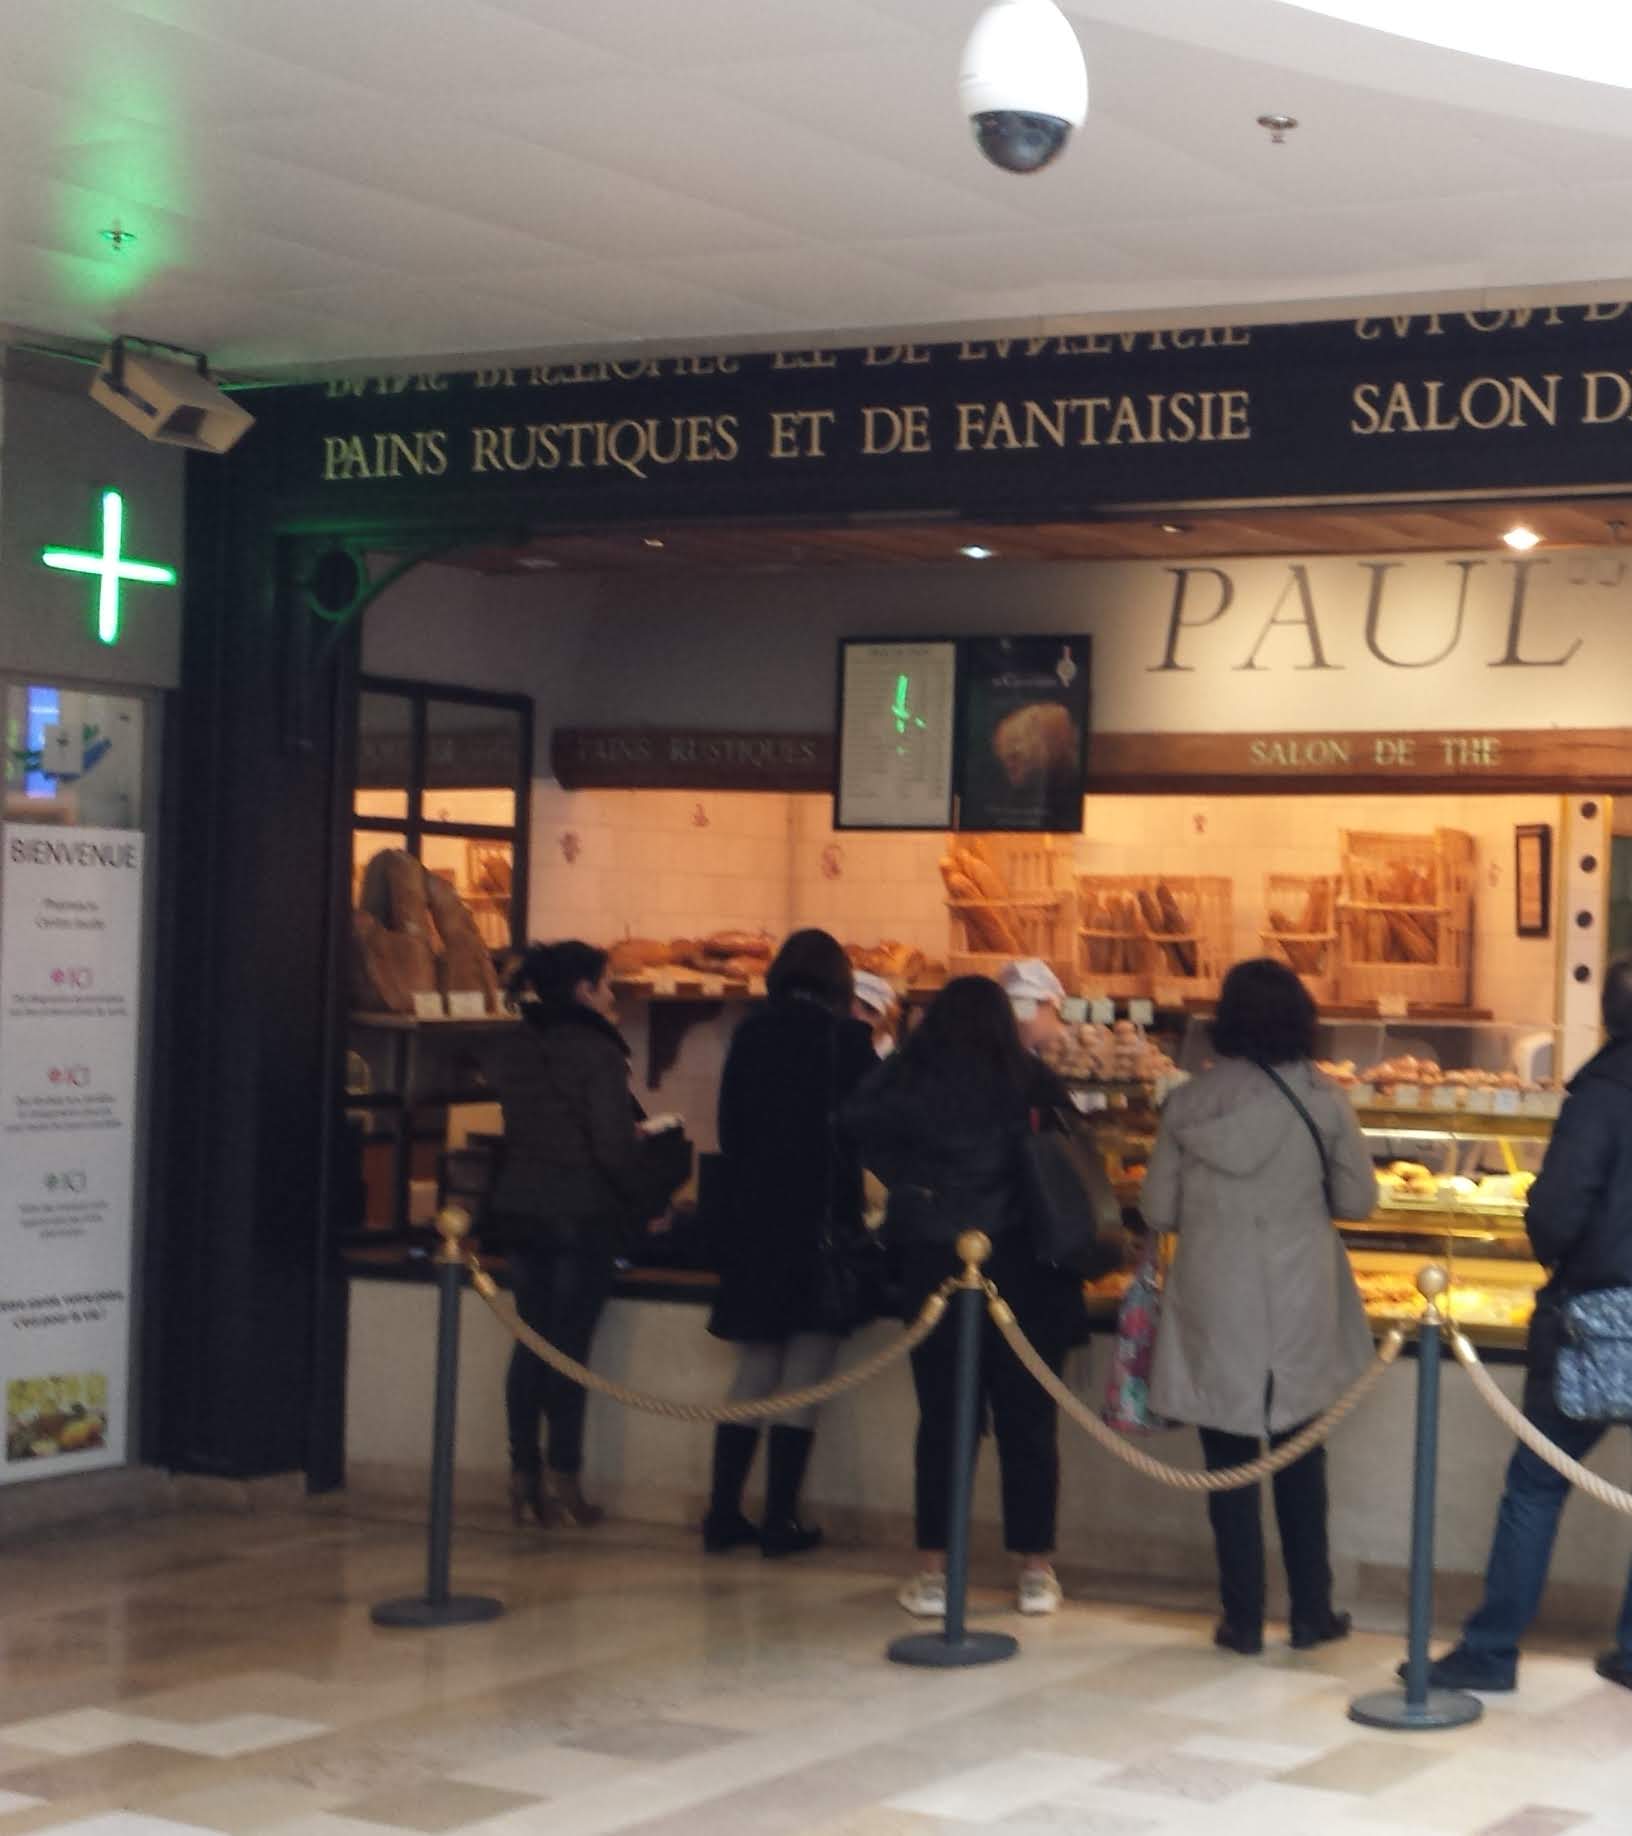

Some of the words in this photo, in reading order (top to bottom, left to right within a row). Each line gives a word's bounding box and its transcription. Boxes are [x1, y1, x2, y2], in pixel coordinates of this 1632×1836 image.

[1350, 375, 1562, 434] SALON
[322, 431, 448, 480] PAINS
[471, 414, 739, 479] RUSTIQUES
[769, 409, 834, 458] ET
[861, 404, 930, 454] DE
[954, 389, 1252, 451] FANTAISIE
[1145, 557, 1584, 672] PAUL
[1250, 738, 1349, 767] SALON
[1375, 737, 1417, 766] DE
[1440, 735, 1501, 767] THE
[9, 837, 138, 869] BIENVENUE
